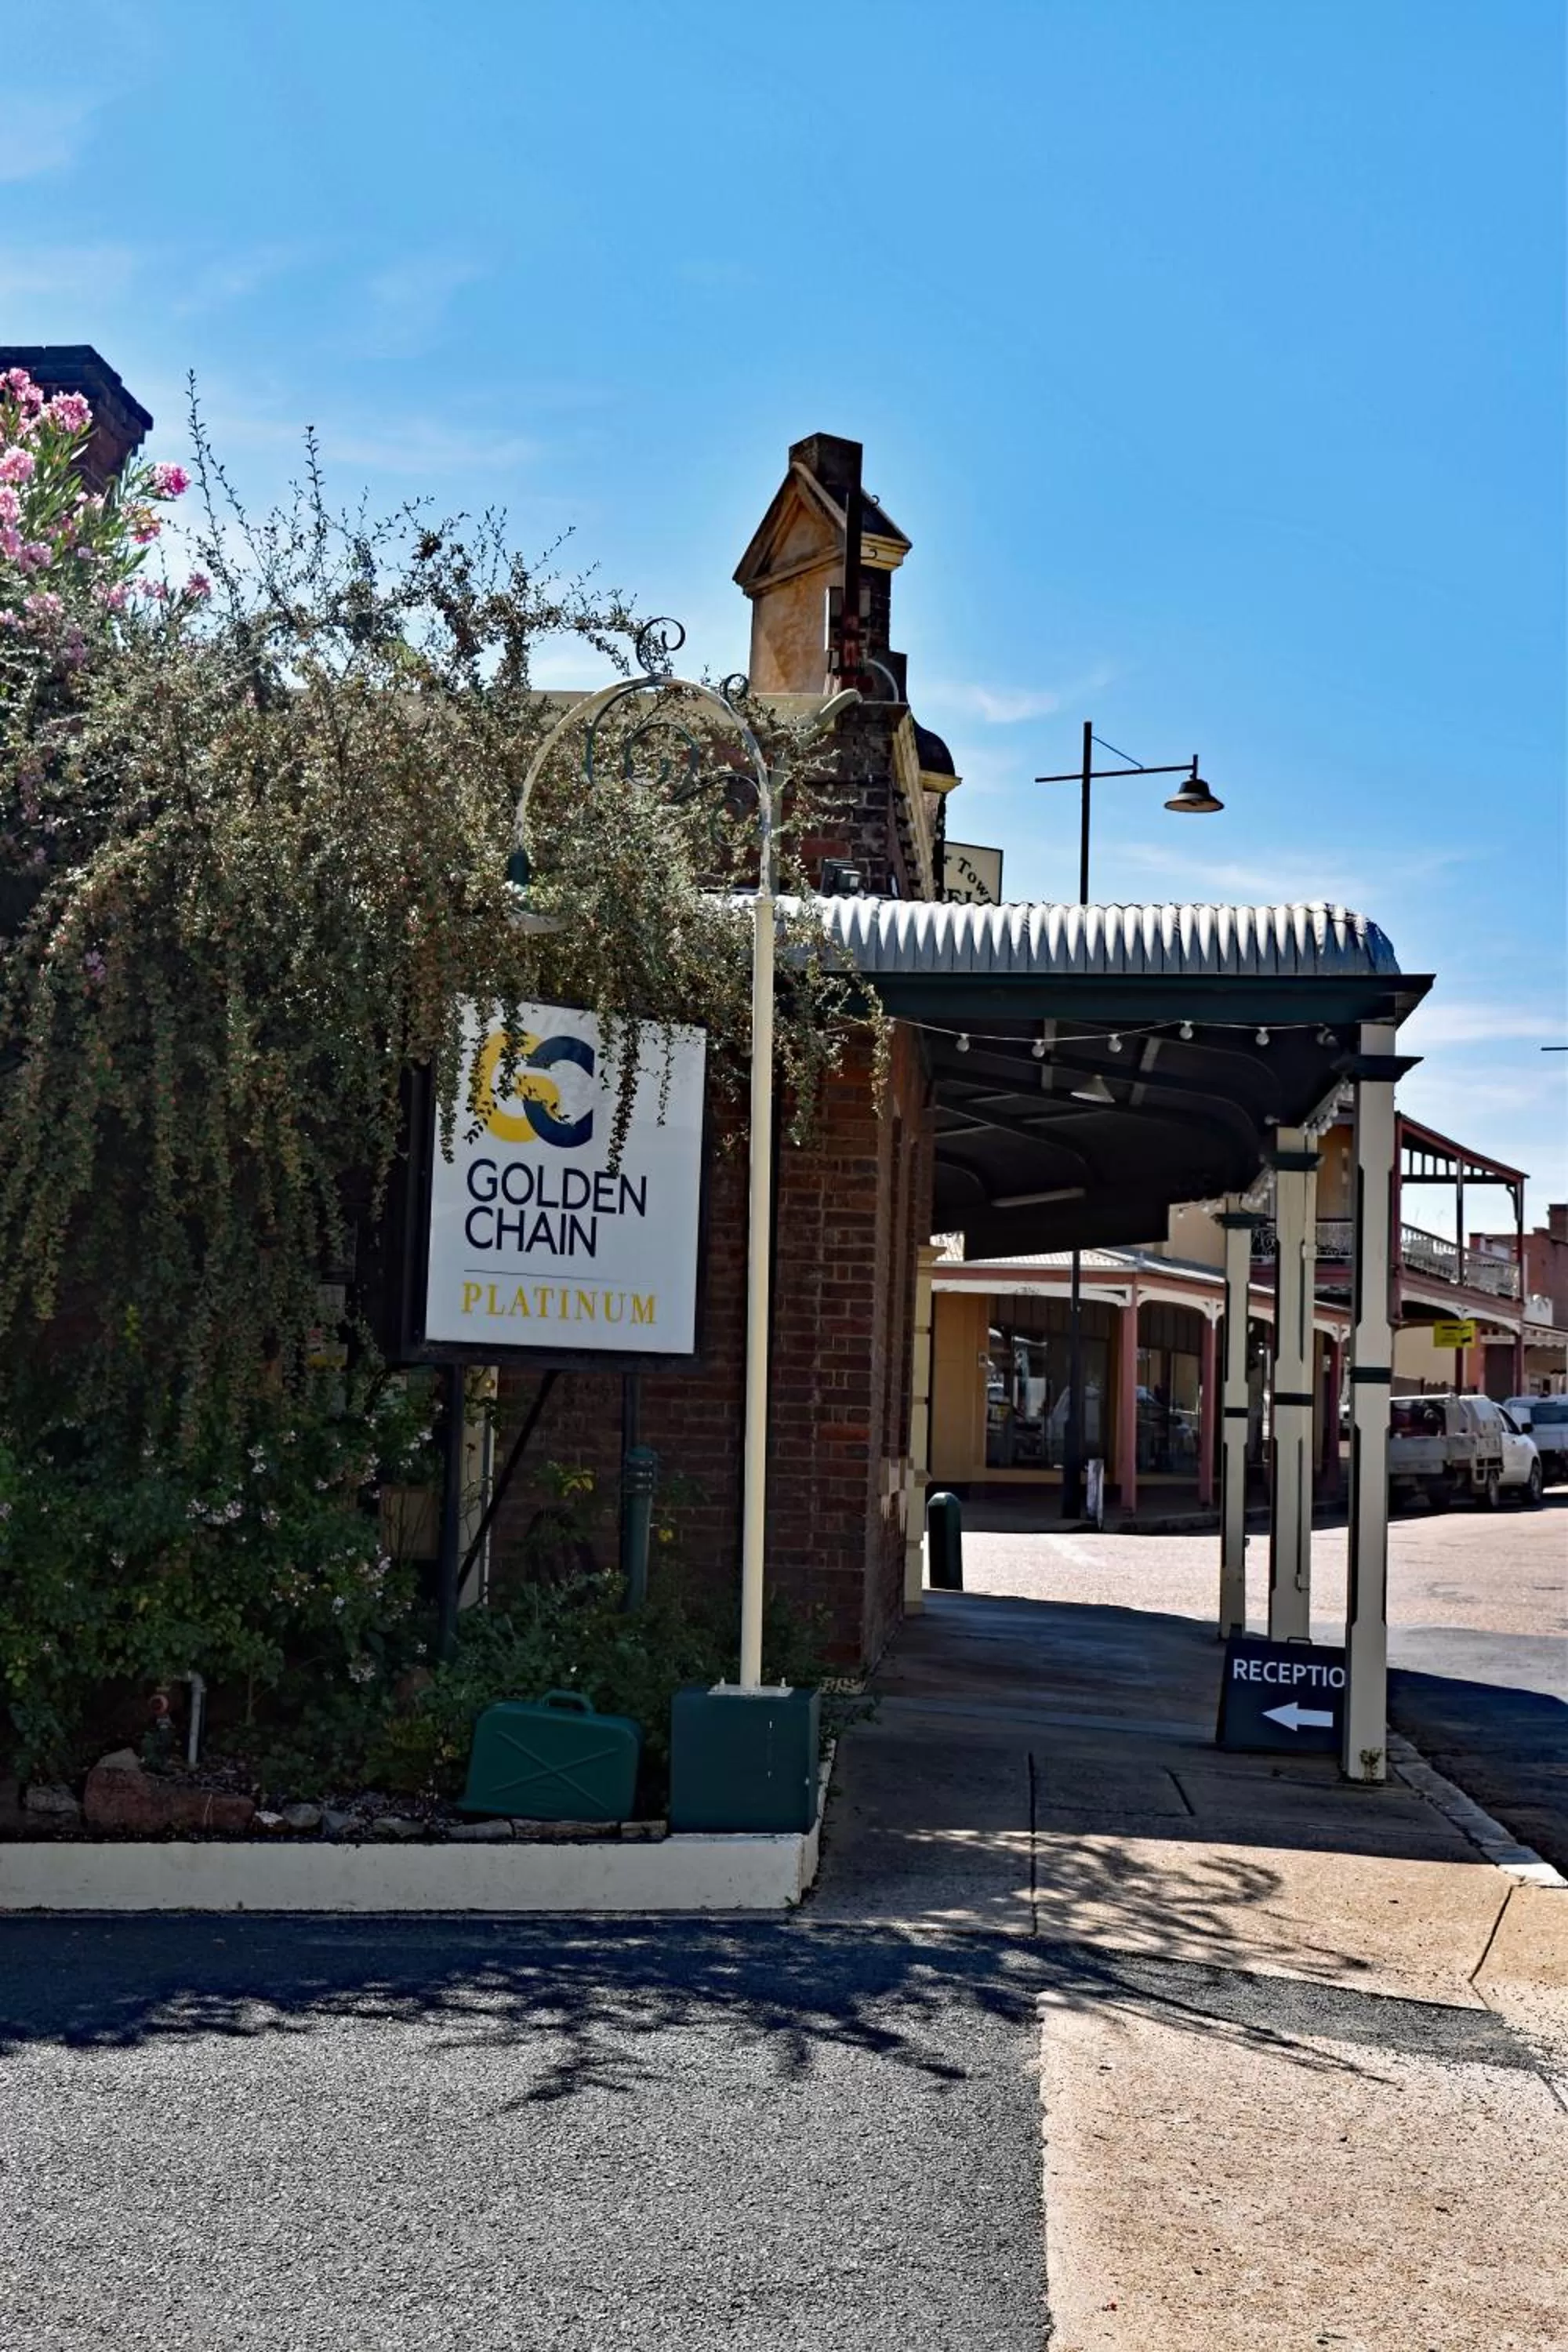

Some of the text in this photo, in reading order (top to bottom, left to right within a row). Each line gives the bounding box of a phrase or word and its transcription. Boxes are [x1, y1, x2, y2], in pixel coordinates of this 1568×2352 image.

[466, 1158, 647, 1217] GOLDEN
[465, 1206, 597, 1258] CHAIN
[461, 1282, 658, 1325] PLATINUM
[1233, 1658, 1345, 1688] RECEPTIO
